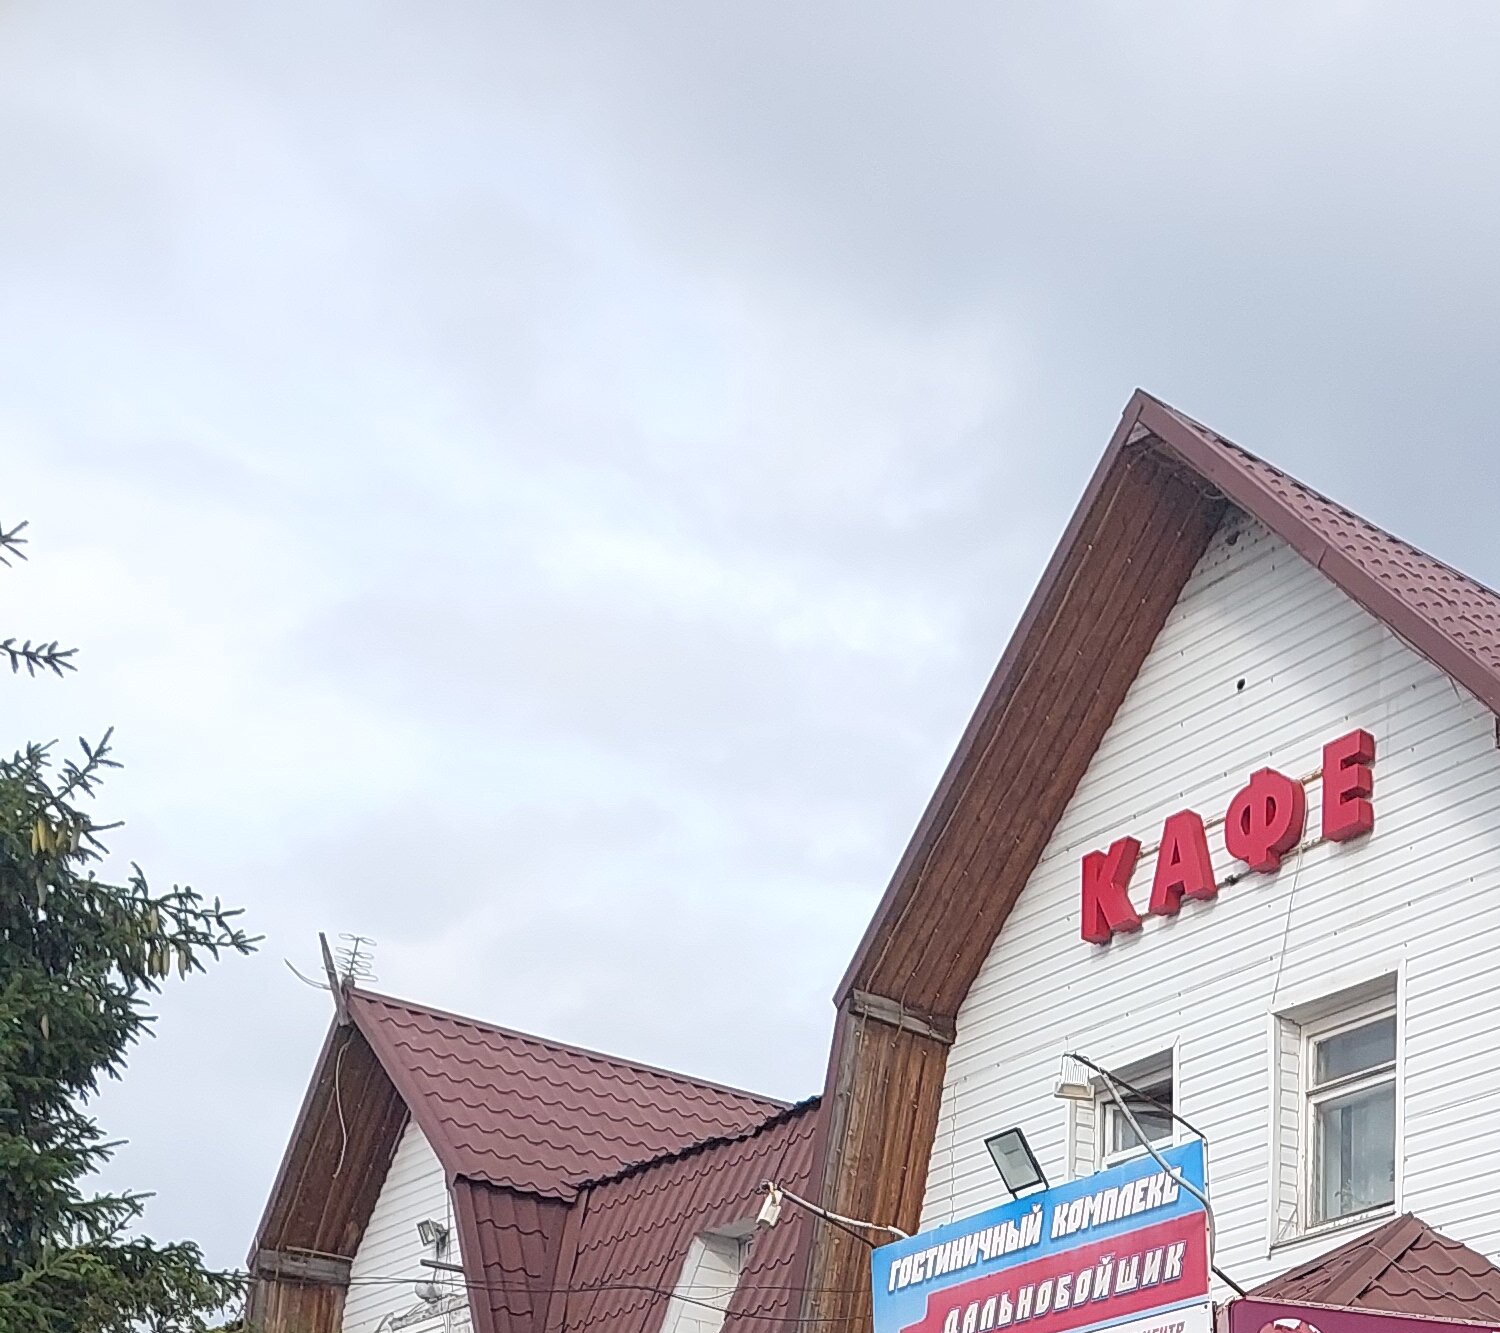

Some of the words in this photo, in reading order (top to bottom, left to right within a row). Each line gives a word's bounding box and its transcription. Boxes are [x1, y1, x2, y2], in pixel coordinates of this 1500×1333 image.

[1081, 728, 1375, 945] КАФЕ
[888, 1203, 1044, 1292] ГОСТИНИЧНЫЙ
[1050, 1165, 1182, 1239] КОМПЛЕКС
